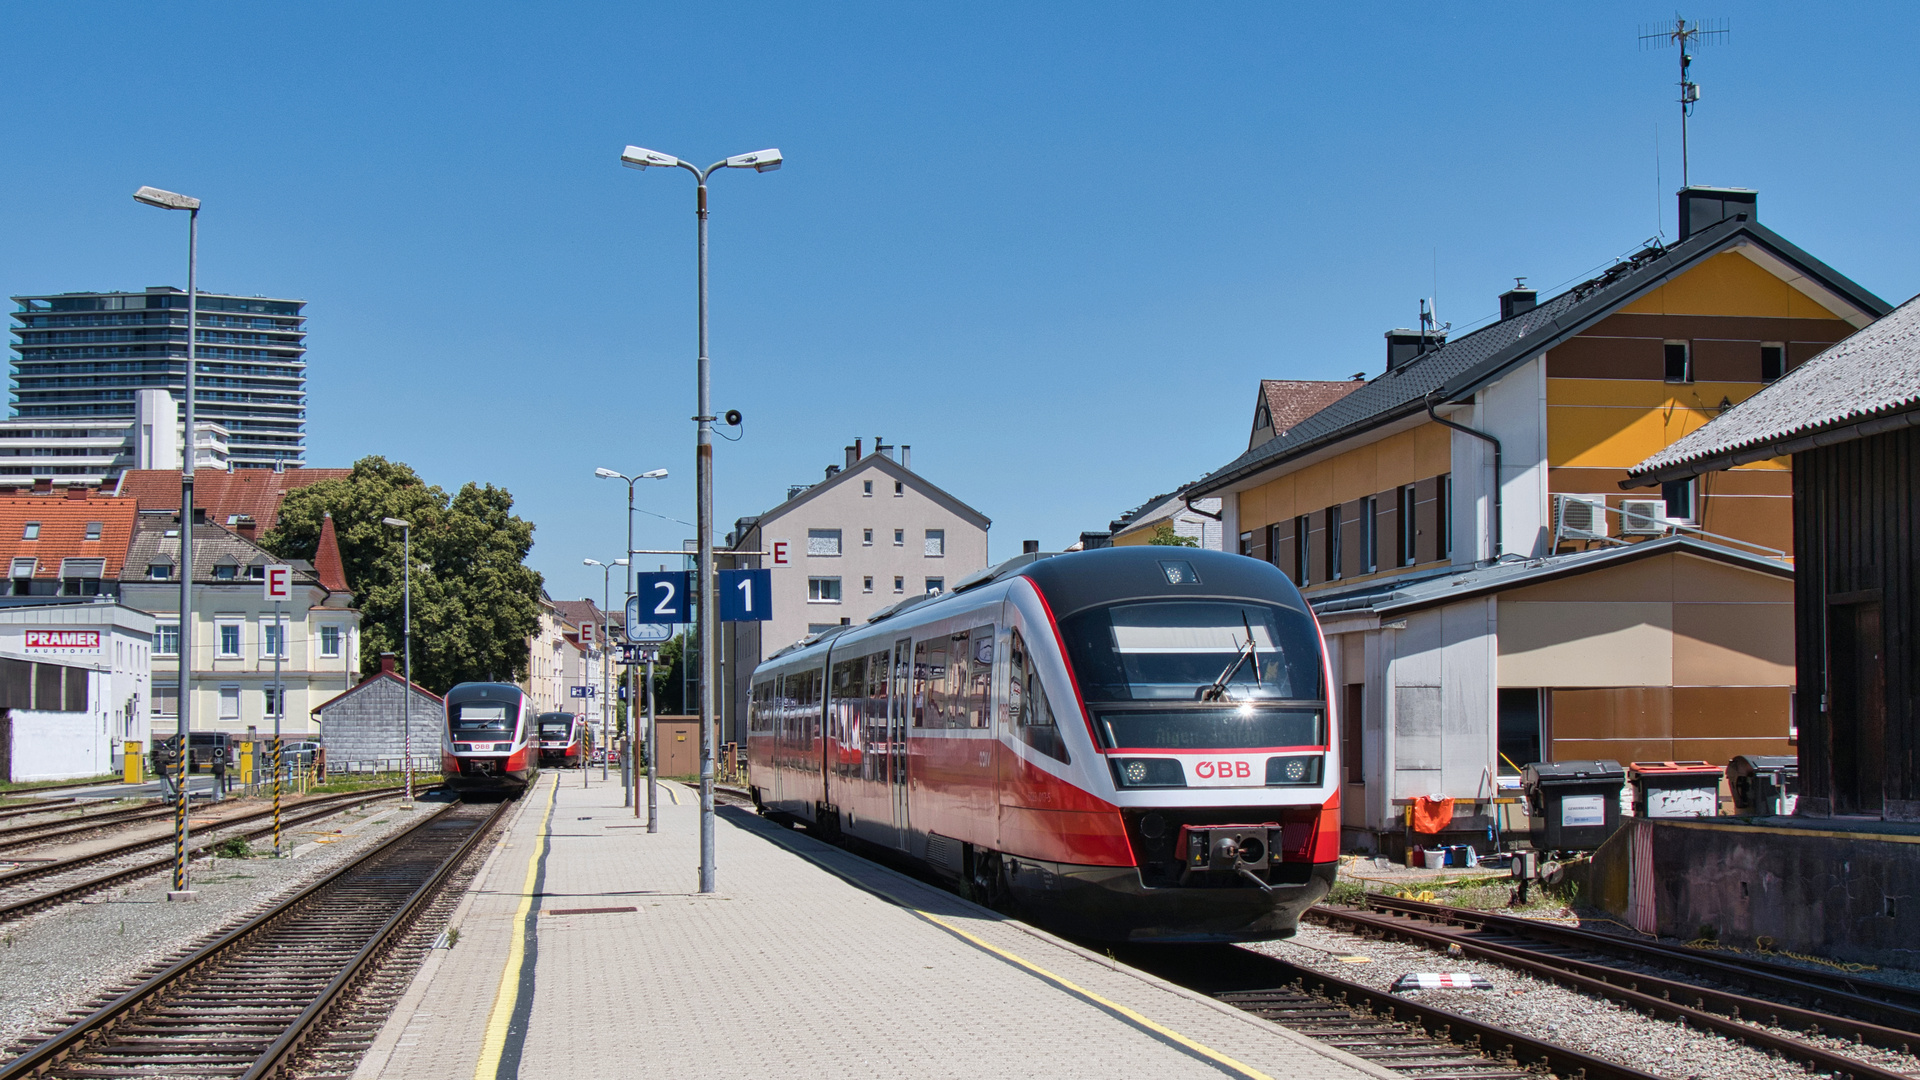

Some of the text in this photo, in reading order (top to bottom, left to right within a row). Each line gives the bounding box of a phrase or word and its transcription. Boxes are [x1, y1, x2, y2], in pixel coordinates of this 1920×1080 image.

[774, 542, 788, 564] E
[270, 569, 286, 596] E
[654, 581, 676, 614] 2
[737, 578, 752, 612] 1
[27, 632, 98, 645] PRAMER
[582, 624, 592, 641] E
[1195, 761, 1251, 779] ÖBB
